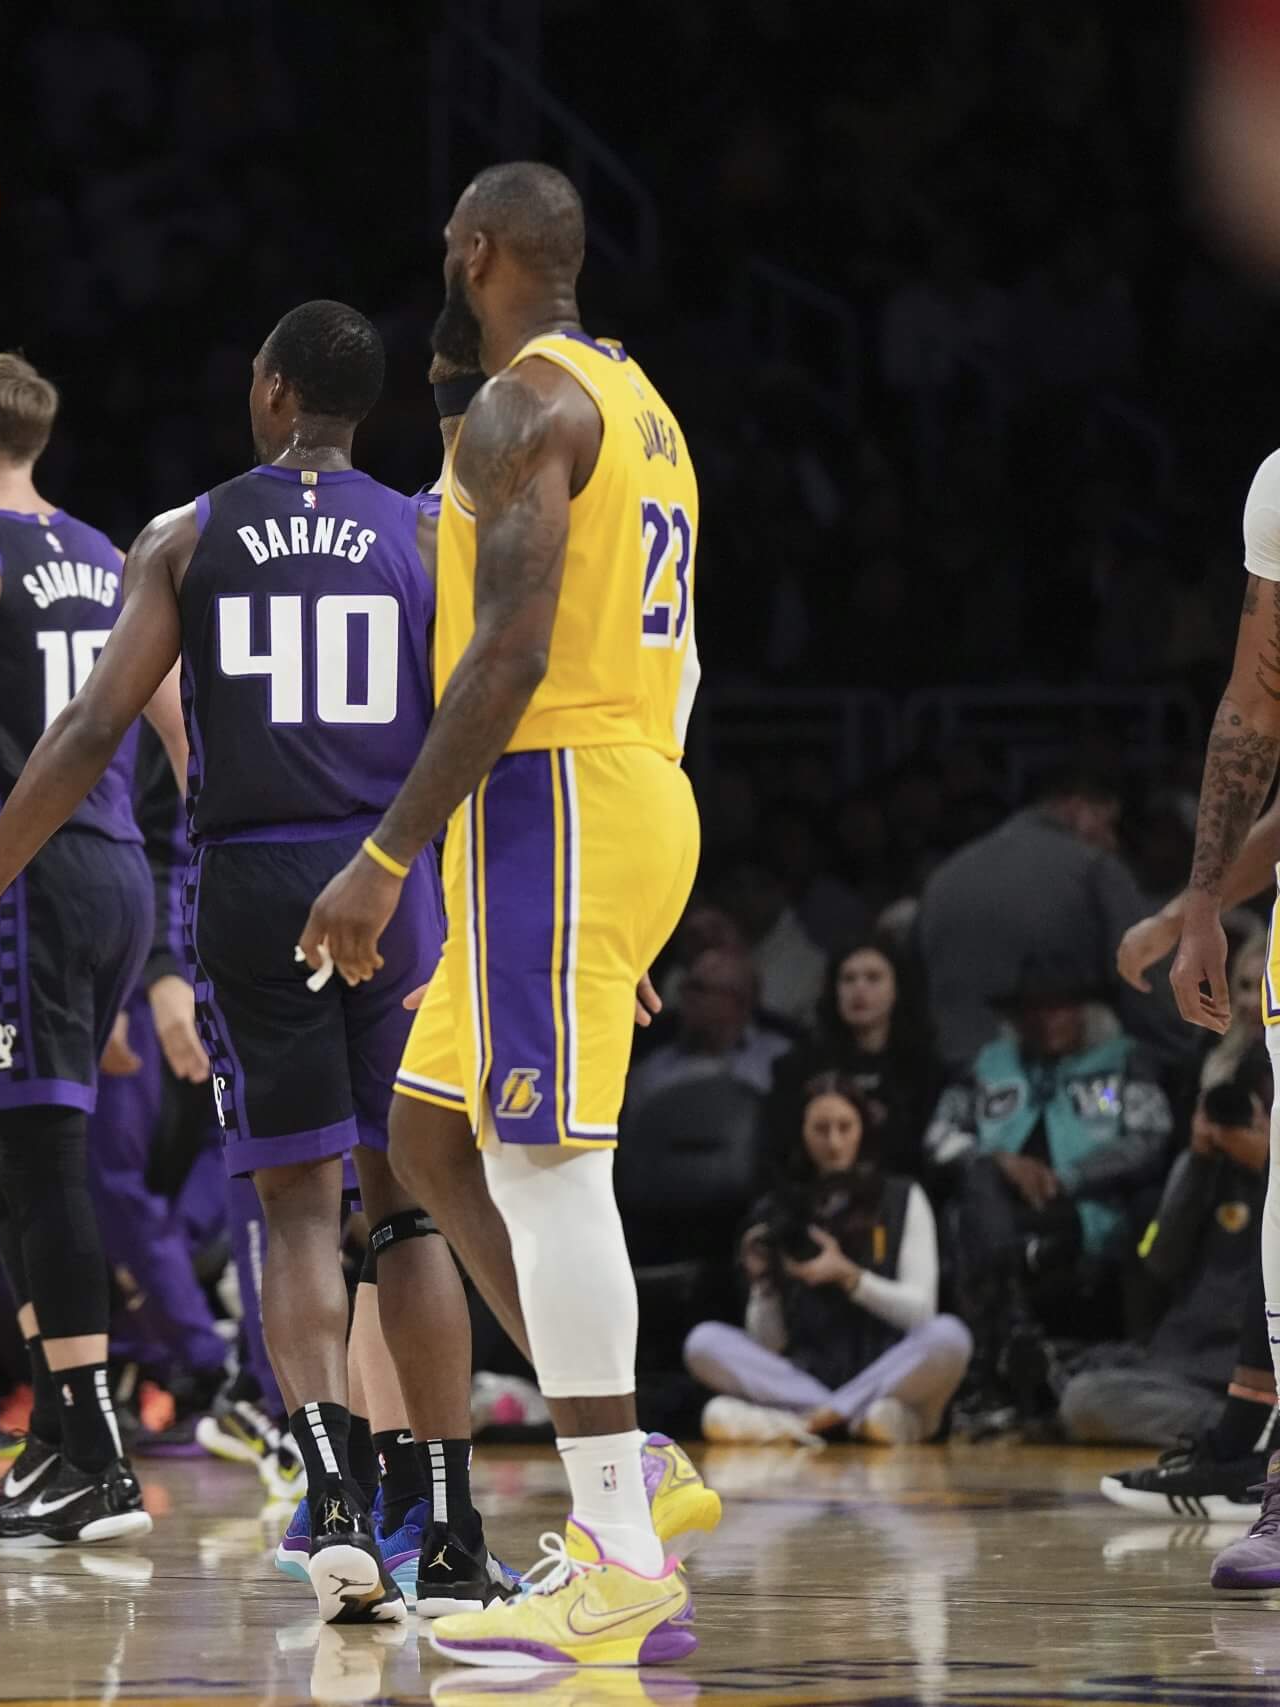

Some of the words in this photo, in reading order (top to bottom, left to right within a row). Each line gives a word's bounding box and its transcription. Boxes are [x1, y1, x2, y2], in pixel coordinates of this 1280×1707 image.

[634, 410, 678, 467] JAMES
[237, 516, 377, 565] BARNES
[22, 561, 119, 609] SABONIS
[640, 498, 692, 652] 23
[218, 594, 399, 724] 40
